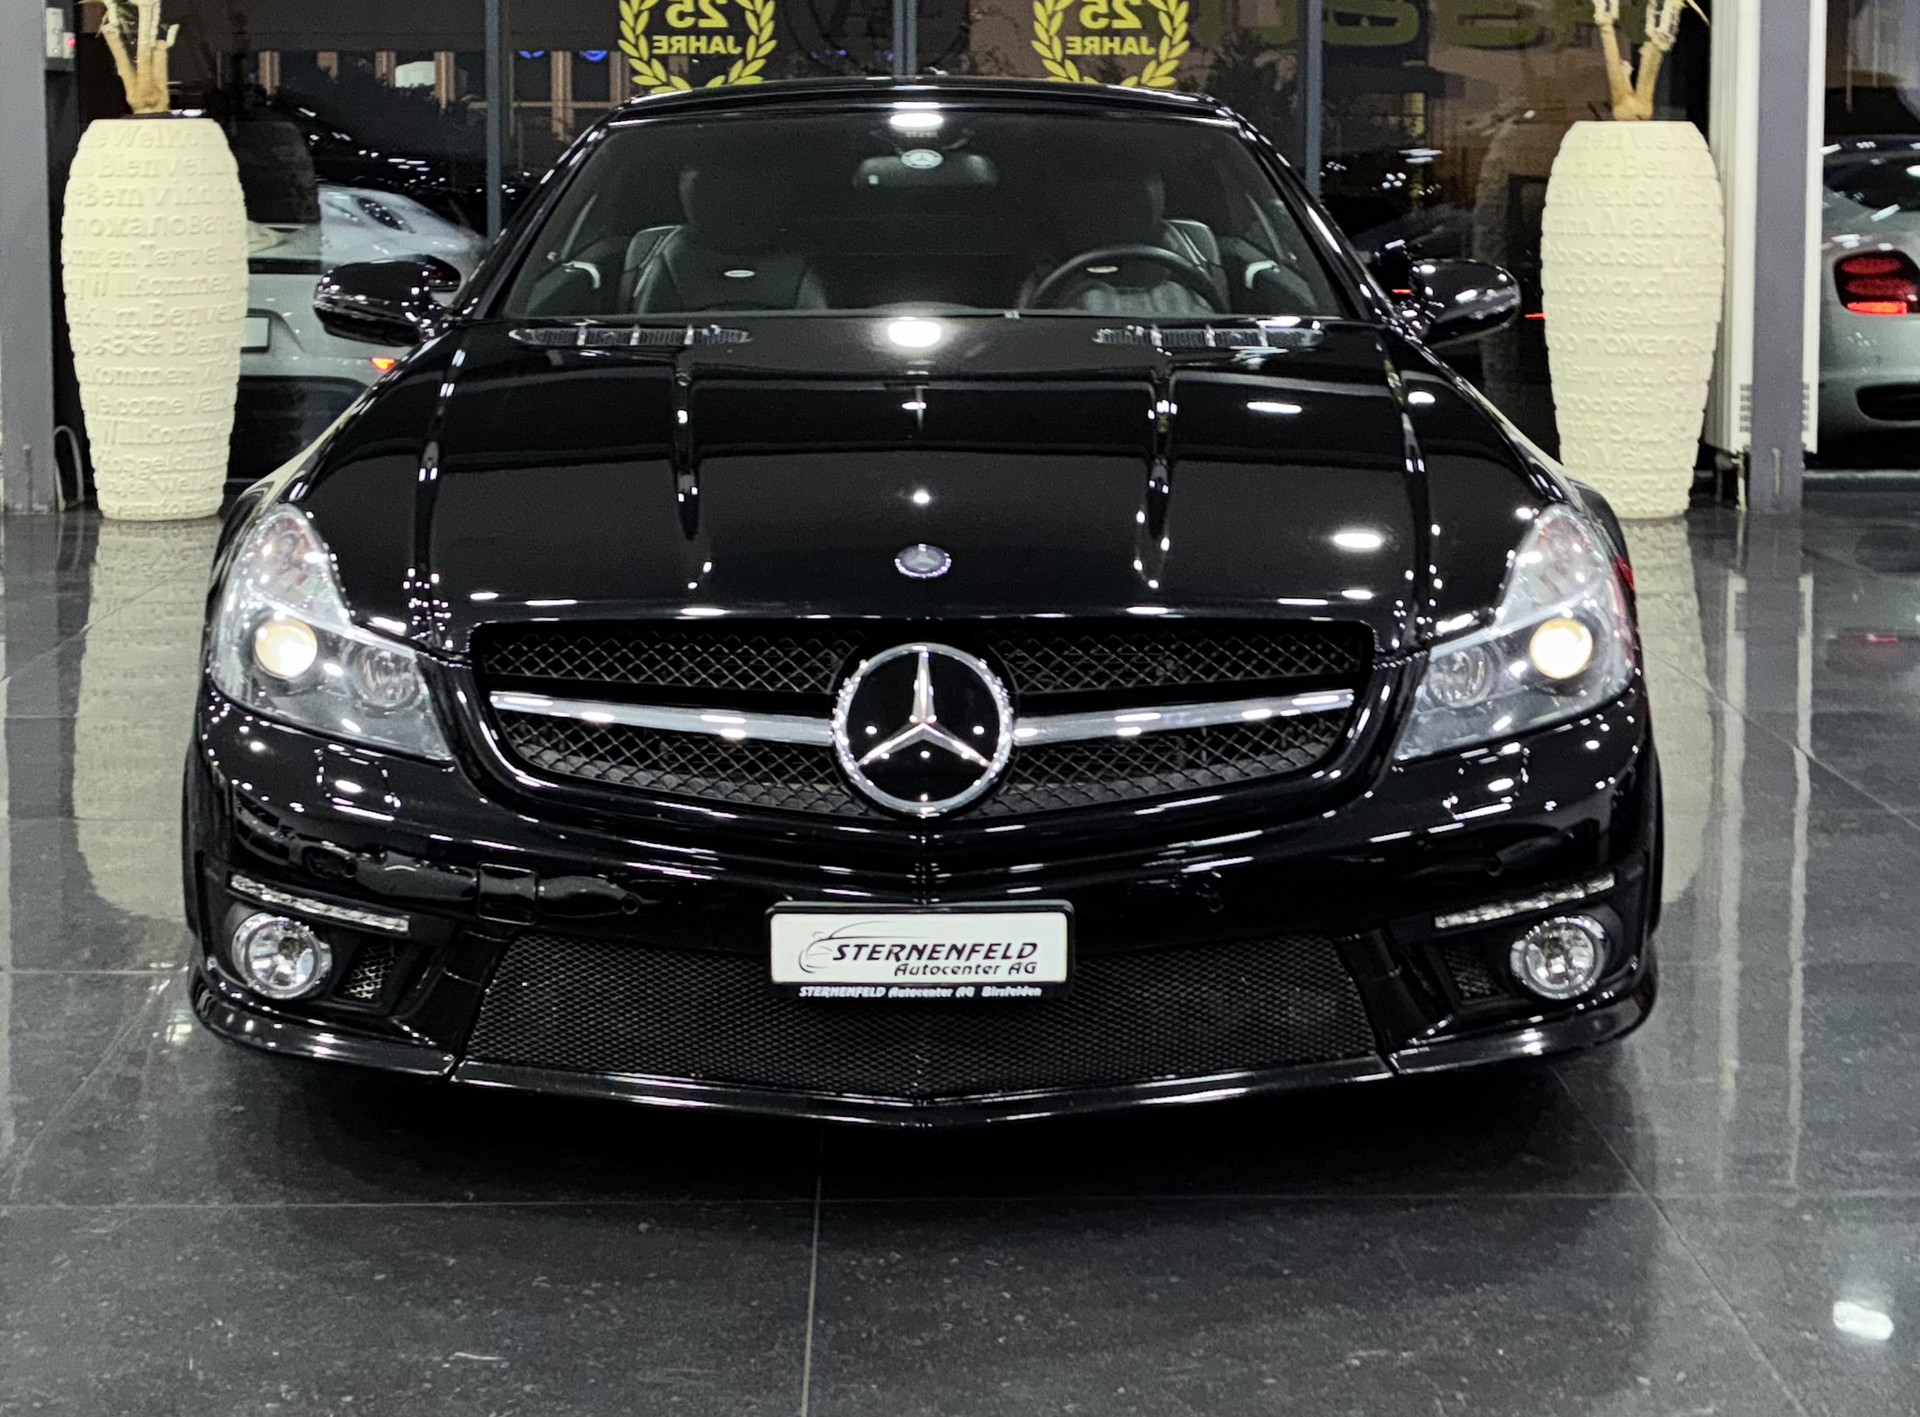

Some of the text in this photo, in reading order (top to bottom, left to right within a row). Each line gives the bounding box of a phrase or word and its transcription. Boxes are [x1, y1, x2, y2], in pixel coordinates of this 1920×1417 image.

[833, 943, 1038, 962] STERNENFELD
[894, 961, 1037, 976] Autocenter AG
[799, 986, 886, 998] STERNENFELD
